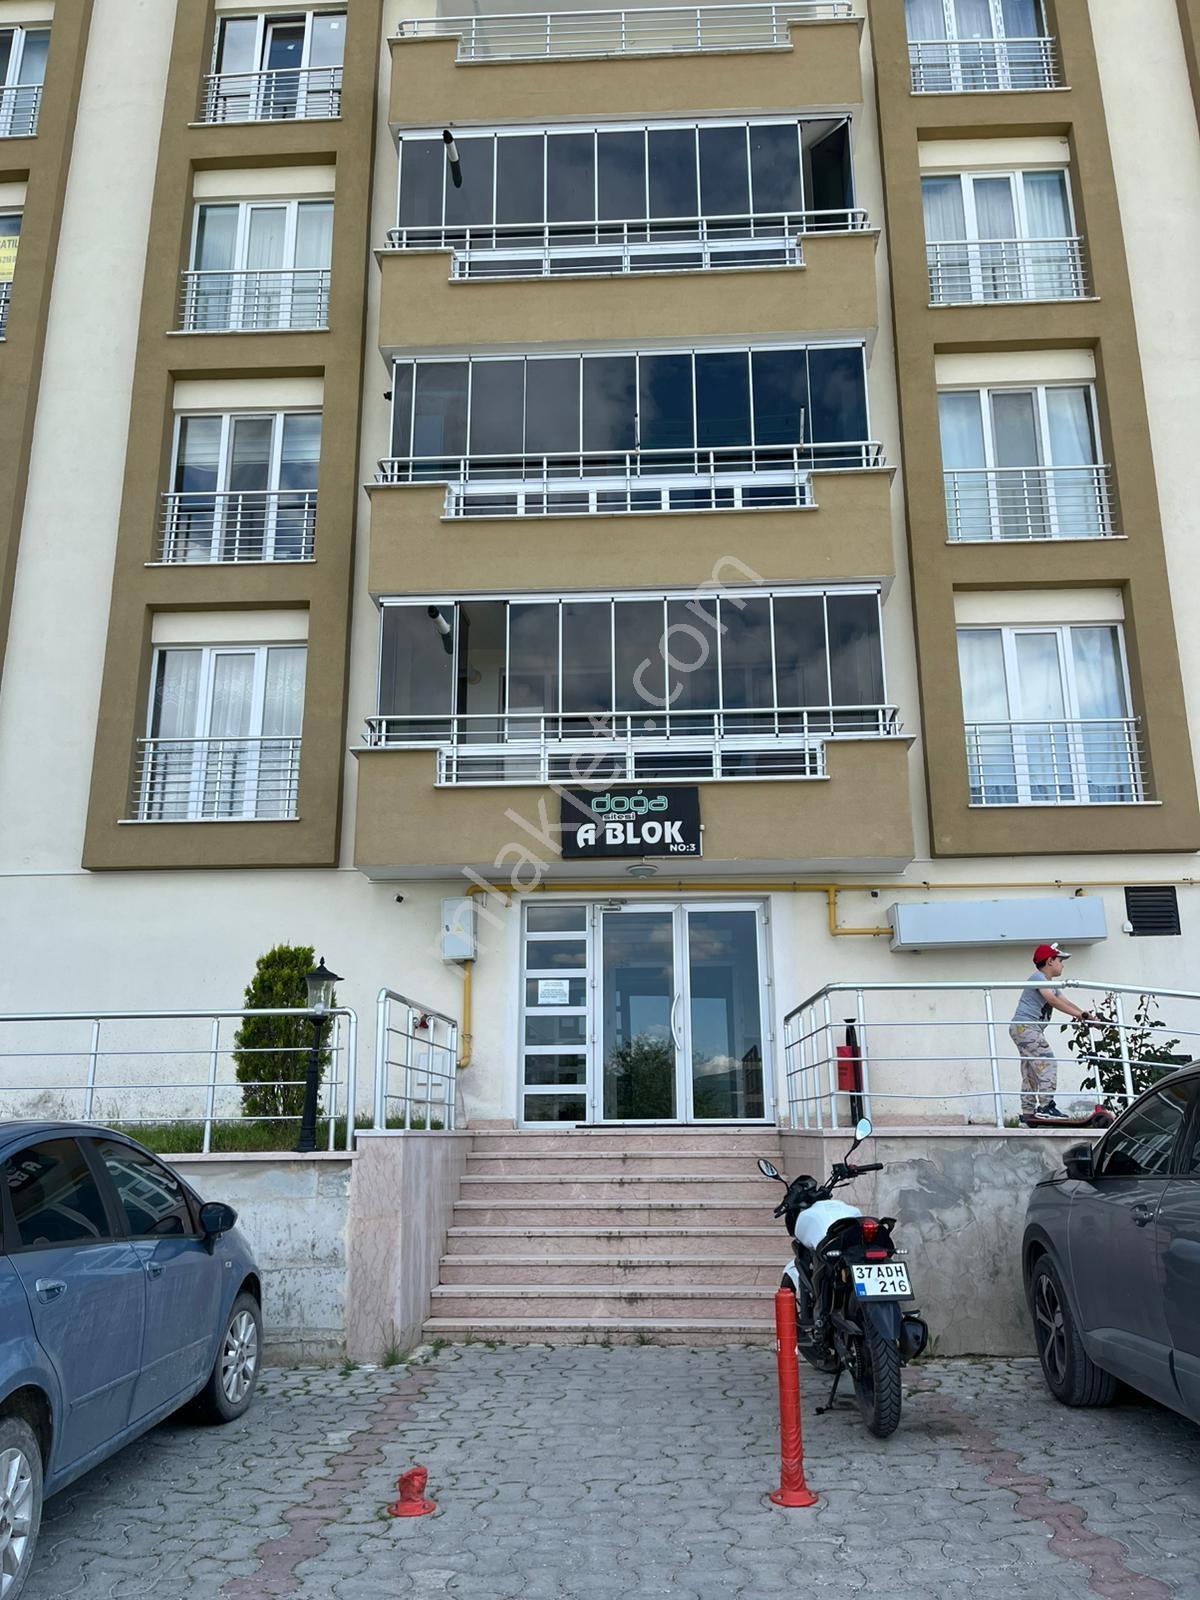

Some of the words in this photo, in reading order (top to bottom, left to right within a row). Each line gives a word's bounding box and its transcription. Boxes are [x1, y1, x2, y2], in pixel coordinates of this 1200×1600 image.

[602, 812, 636, 821] sitesi
[576, 823, 597, 848] A
[605, 821, 684, 845] BLOK
[669, 843, 696, 852] NO:3
[856, 1266, 873, 1279] 37
[877, 1266, 904, 1278] ADH
[879, 1280, 907, 1292] 216
